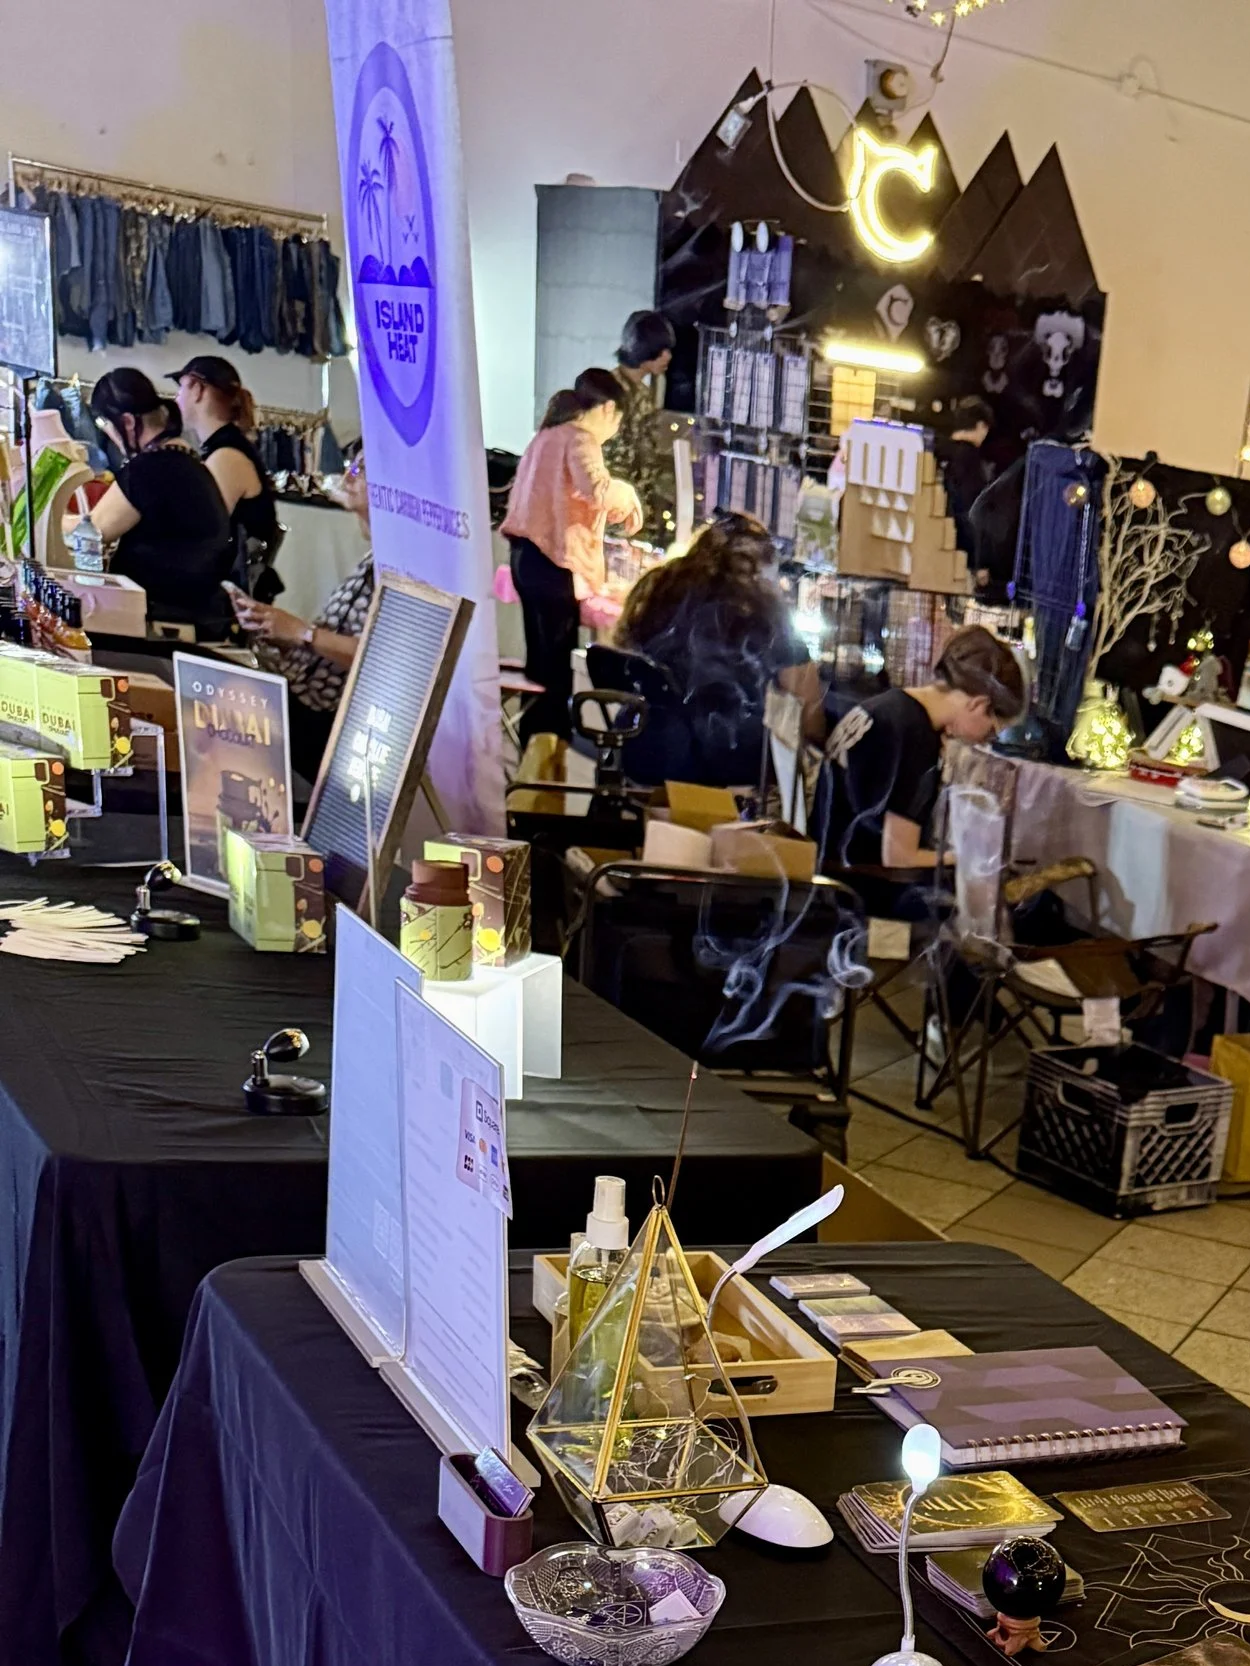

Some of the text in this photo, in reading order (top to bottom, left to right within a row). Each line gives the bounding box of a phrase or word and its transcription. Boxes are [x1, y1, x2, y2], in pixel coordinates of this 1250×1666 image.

[375, 299, 424, 333] ISLAND
[387, 332, 419, 363] HEAT
[191, 680, 268, 709] ODYSSEY
[1, 702, 35, 721] DUBAI
[42, 711, 76, 732] DUBAI
[193, 699, 271, 746] DUBAI
